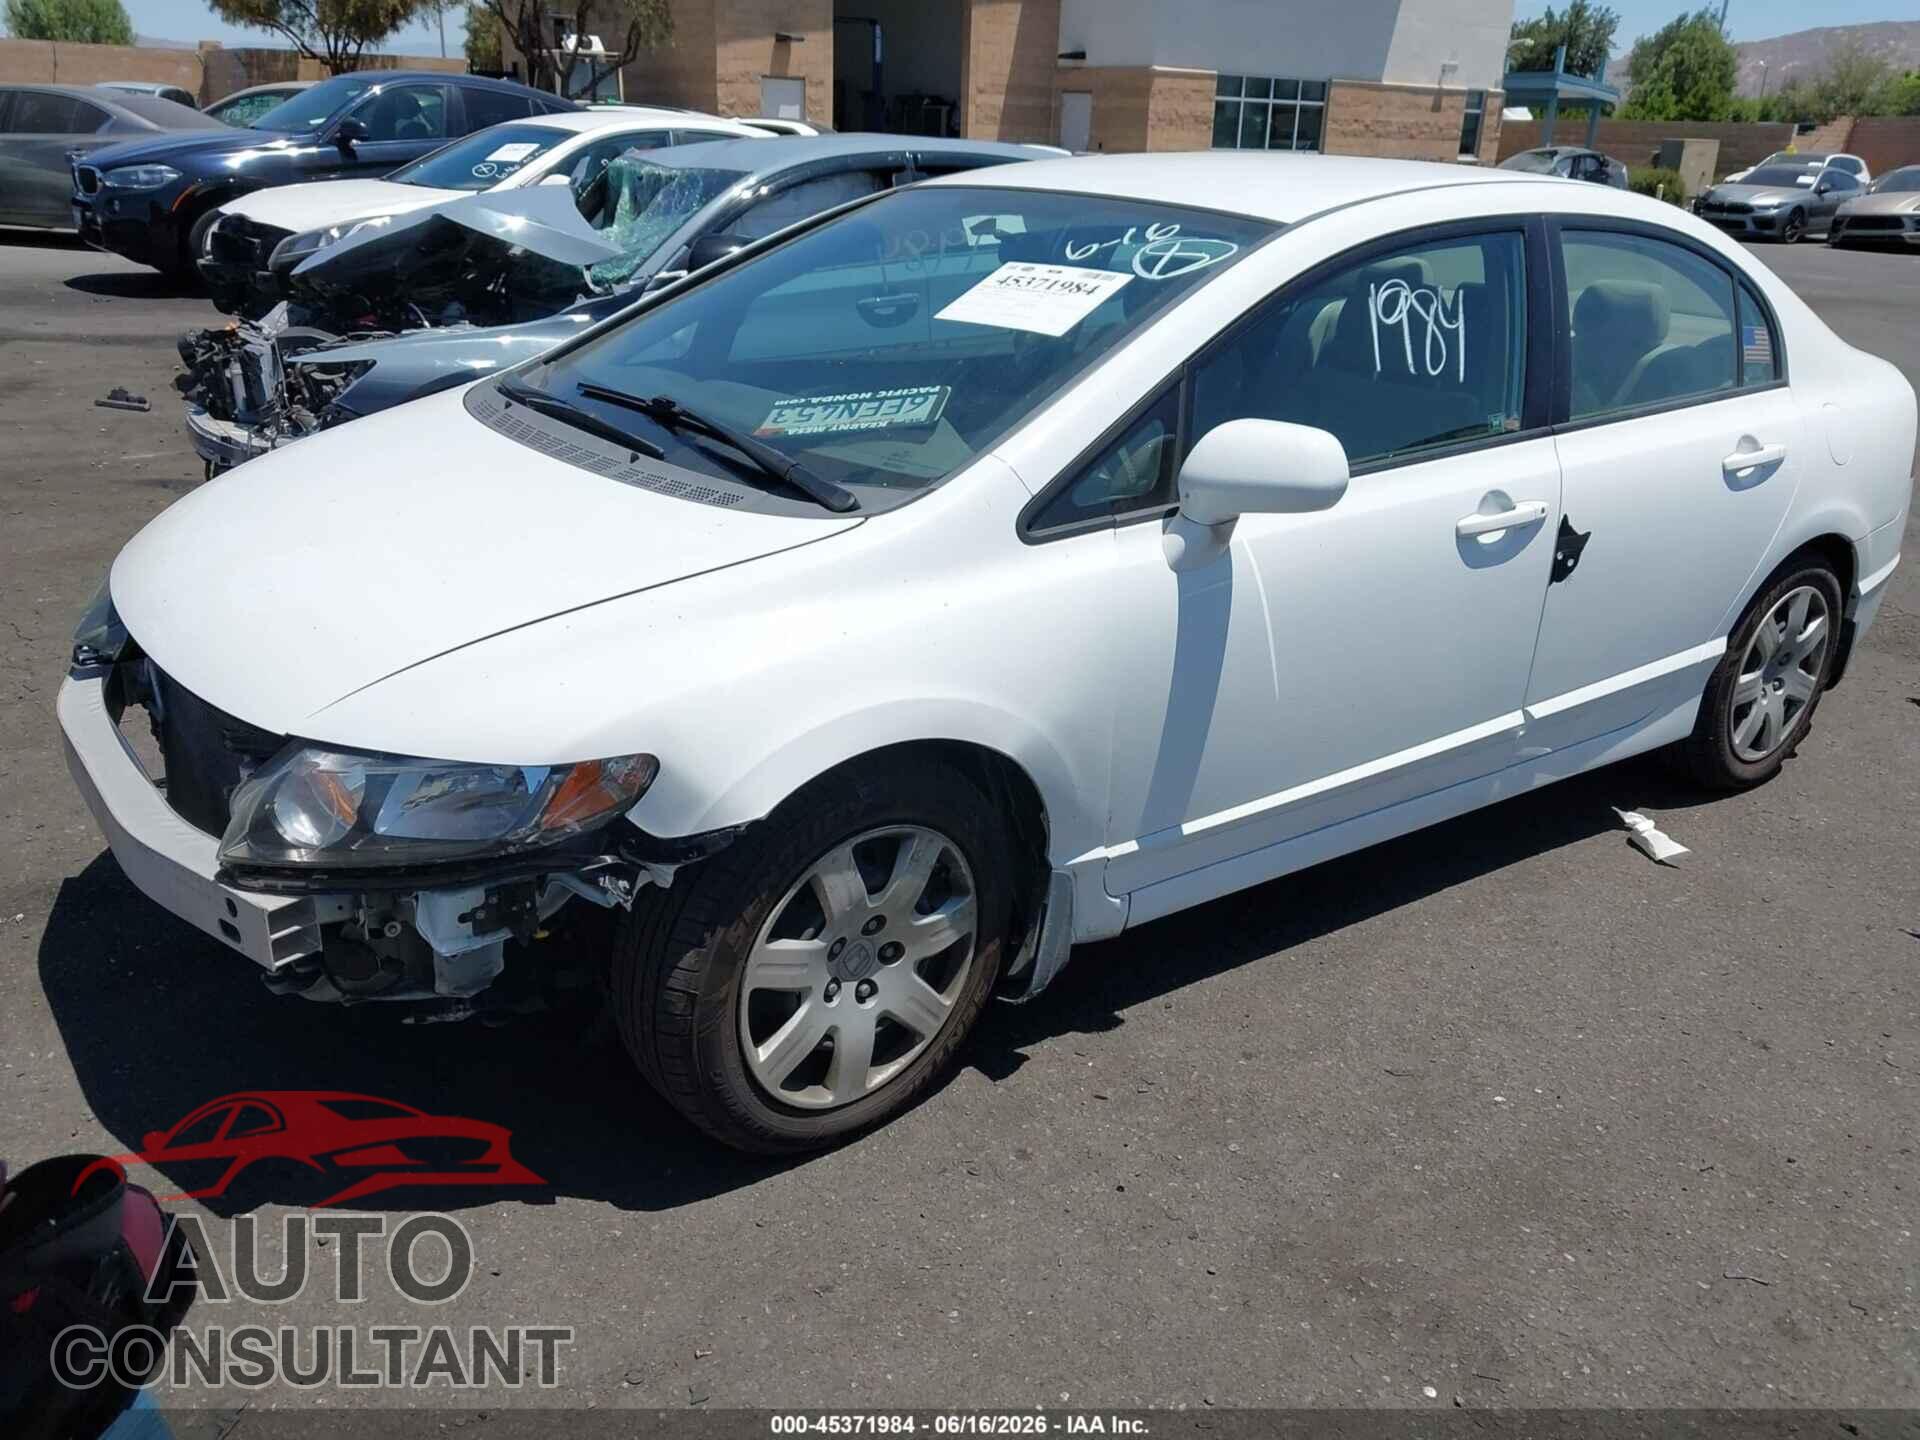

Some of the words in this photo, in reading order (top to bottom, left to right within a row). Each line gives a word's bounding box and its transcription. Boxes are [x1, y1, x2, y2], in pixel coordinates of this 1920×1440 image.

[997, 274, 1101, 296] 45371984
[1368, 278, 1465, 383] 1984
[876, 385, 941, 398] PACIFIC
